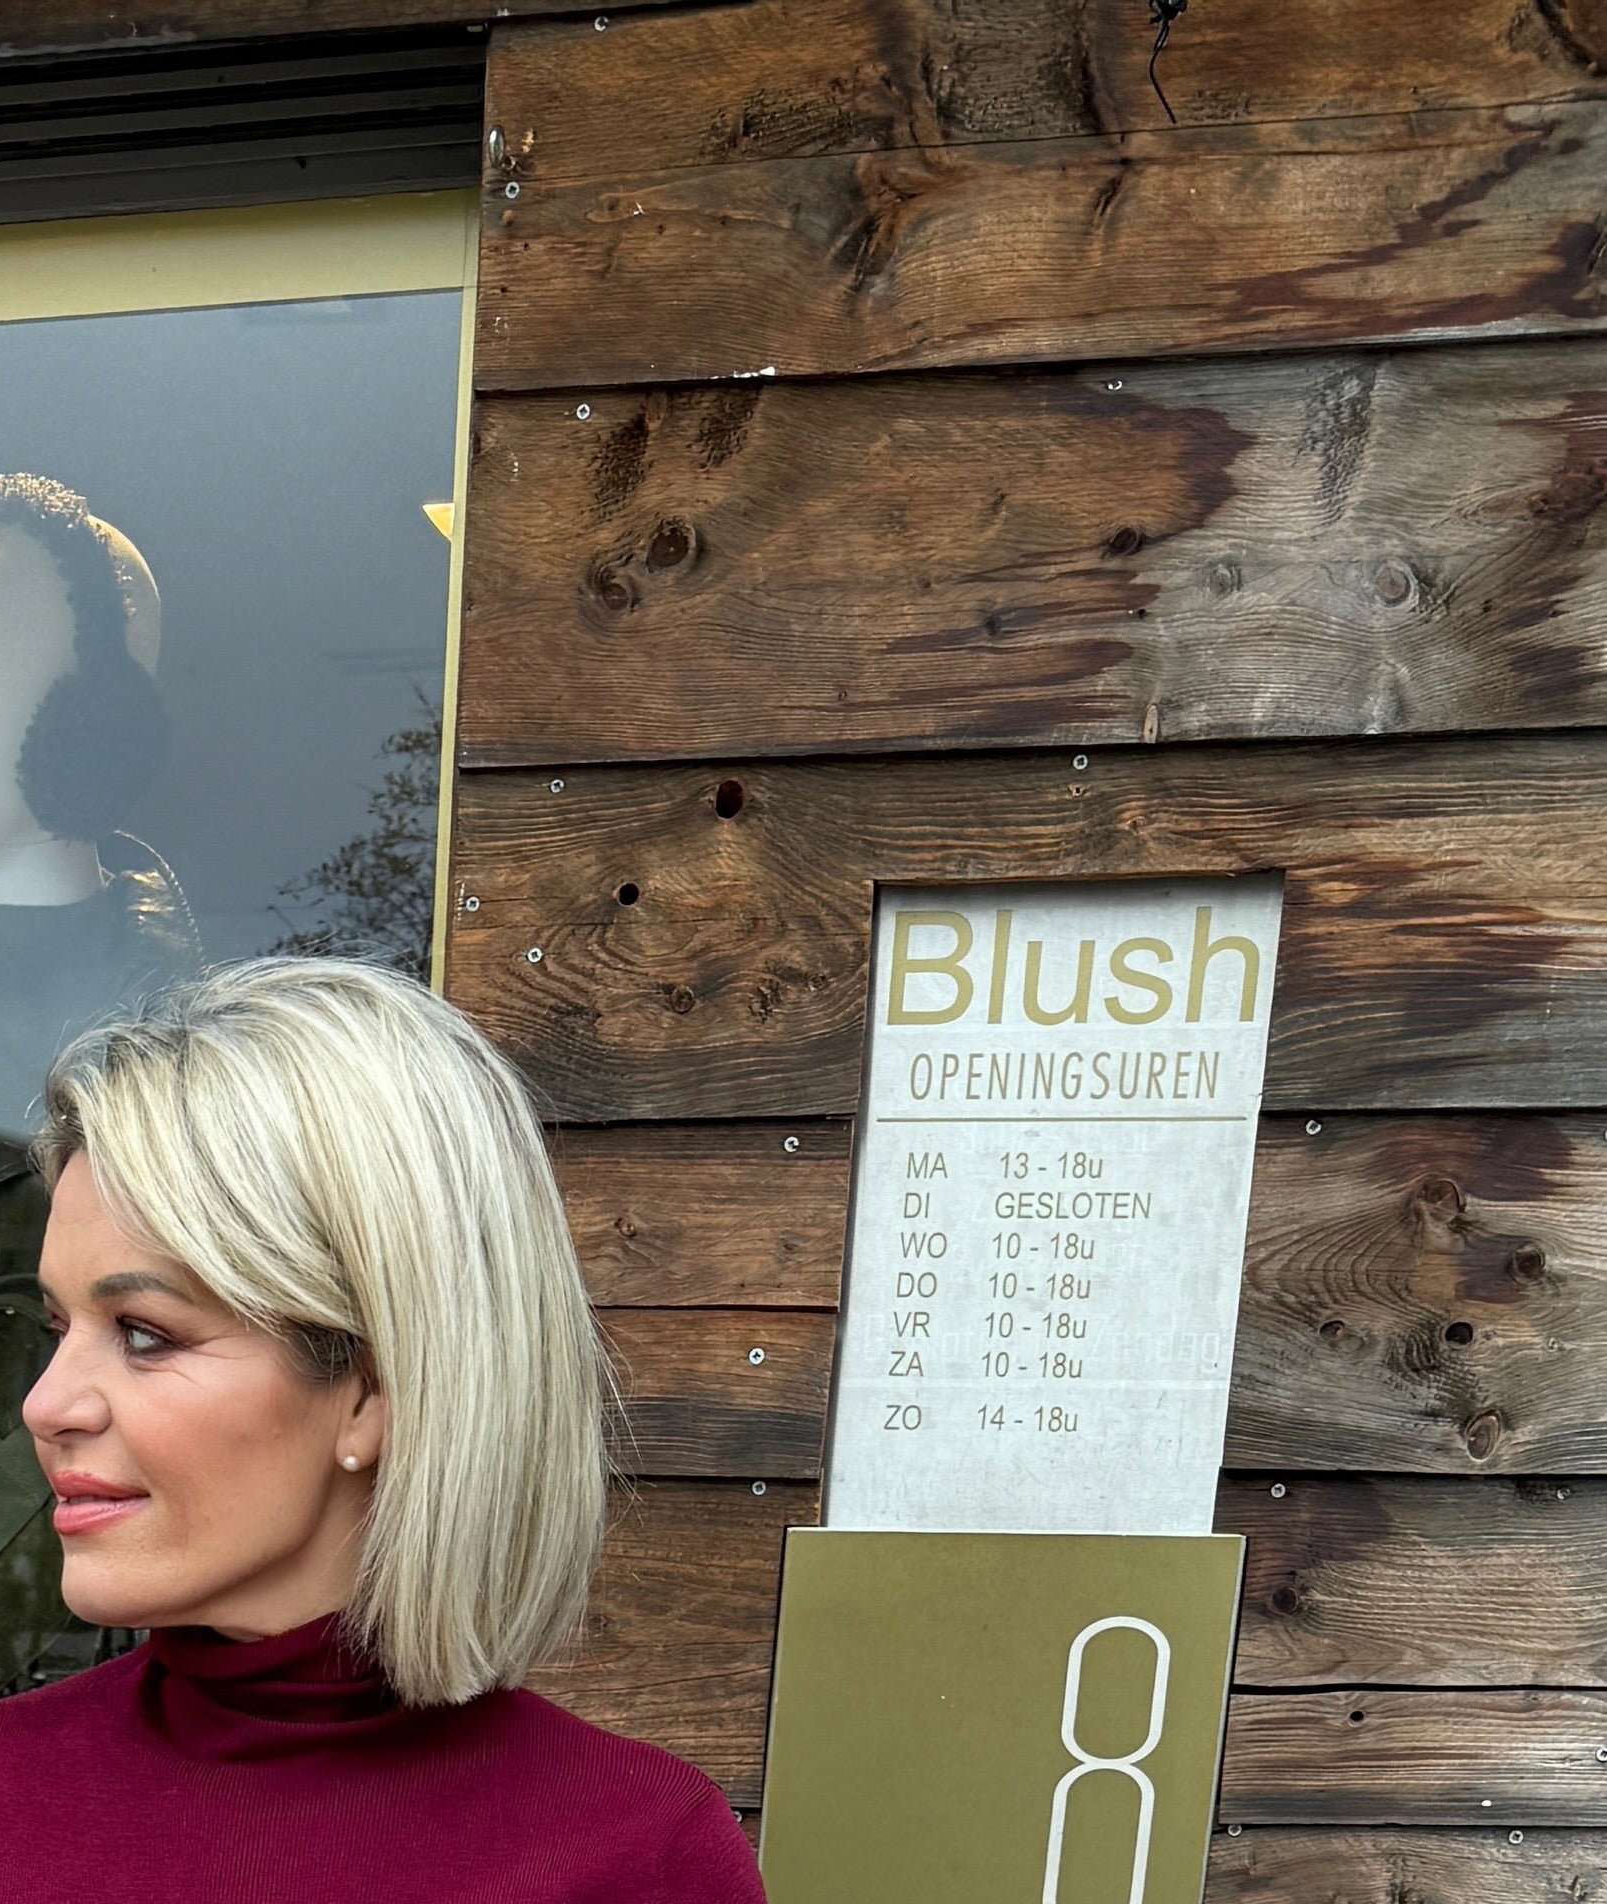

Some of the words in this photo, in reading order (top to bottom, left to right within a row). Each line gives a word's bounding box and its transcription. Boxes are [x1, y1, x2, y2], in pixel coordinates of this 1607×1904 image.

[886, 906, 1261, 1025] Blush
[911, 1051, 1219, 1100] OPENINGSUREN
[907, 1152, 948, 1179] MA
[1001, 1152, 1028, 1179] 13
[1058, 1152, 1103, 1179] 18u
[904, 1192, 930, 1218] DI
[995, 1192, 1151, 1219] GESLOTEN
[901, 1232, 947, 1258] WO
[993, 1232, 1021, 1259] 10
[1051, 1232, 1094, 1259] 18u
[897, 1272, 937, 1298] DO
[989, 1272, 1017, 1299] 10
[1047, 1273, 1091, 1300] 18u
[894, 1312, 930, 1338] VR
[985, 1312, 1013, 1338] 10
[1043, 1312, 1086, 1339] 18u
[889, 1351, 924, 1377] ZA
[982, 1352, 1009, 1377] 10
[1039, 1352, 1082, 1378] 18u
[884, 1405, 922, 1430] ZO
[978, 1404, 1005, 1431] 14
[1035, 1406, 1078, 1432] 18u
